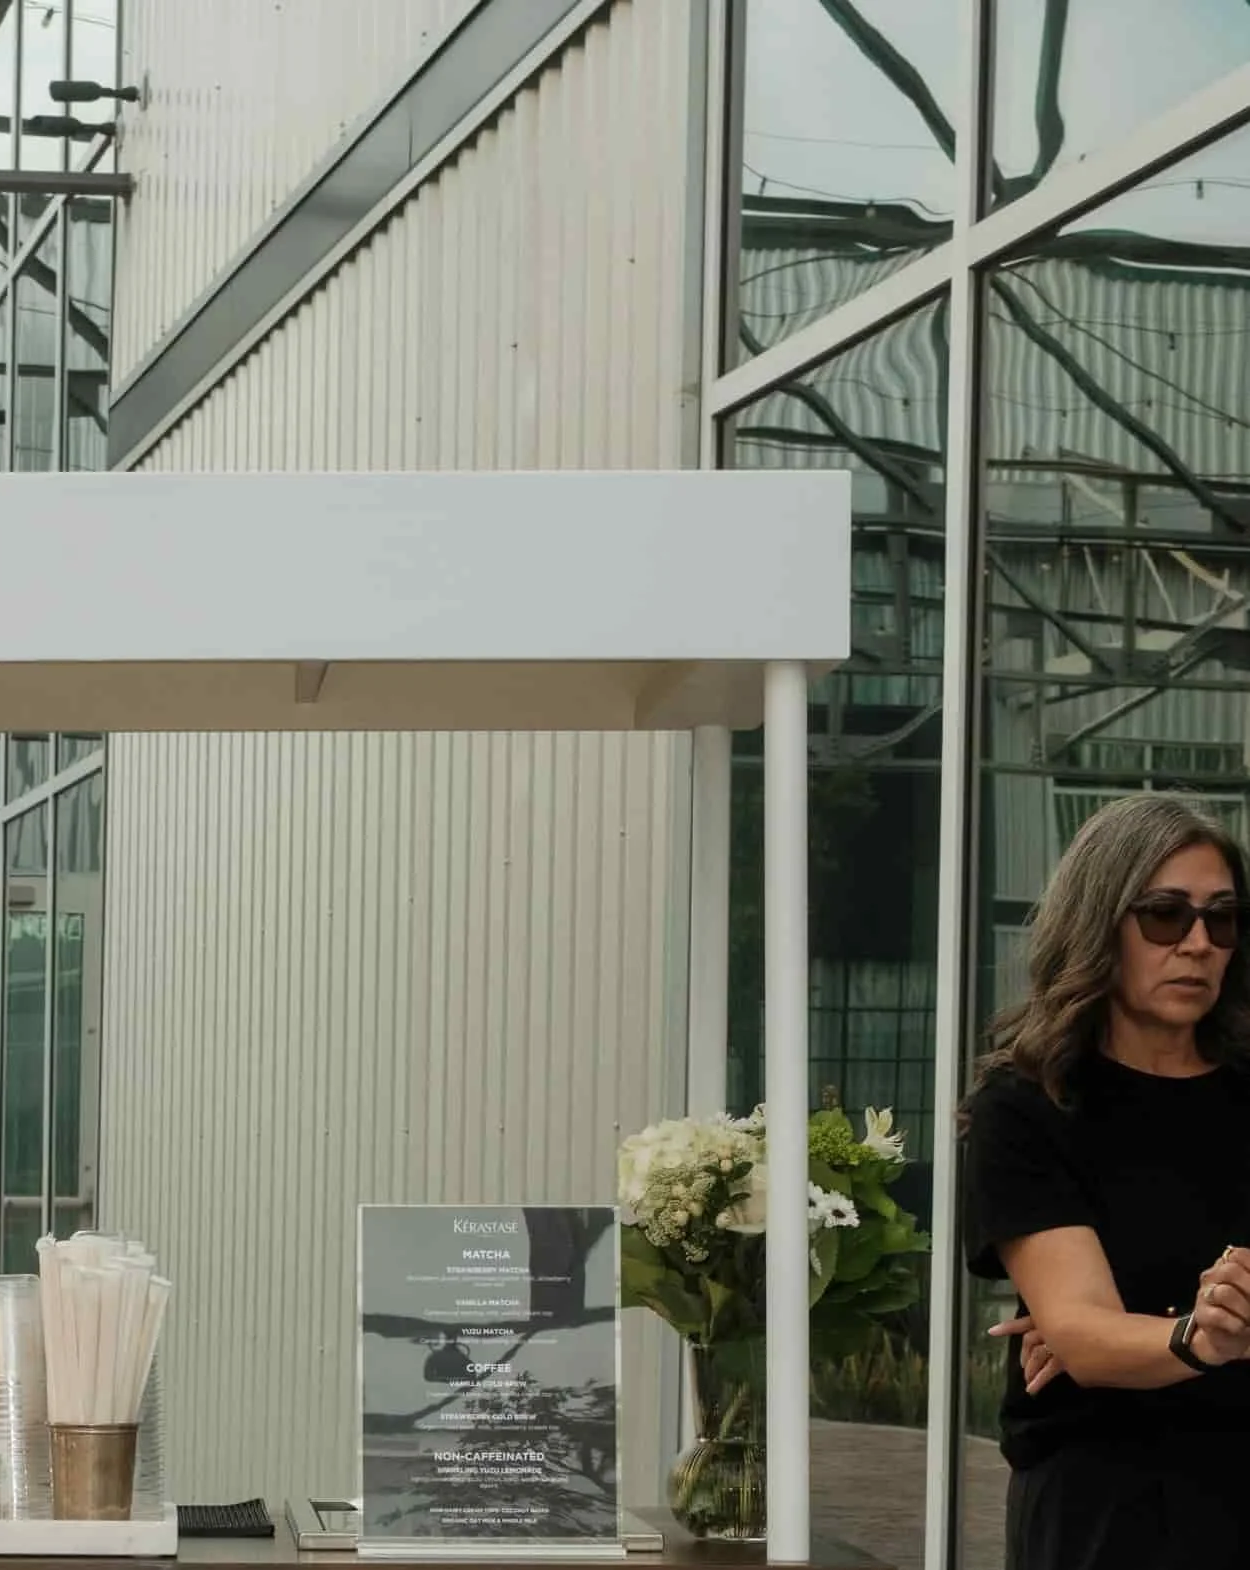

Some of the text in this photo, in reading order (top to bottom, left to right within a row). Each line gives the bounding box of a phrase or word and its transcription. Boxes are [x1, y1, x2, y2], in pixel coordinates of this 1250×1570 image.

[462, 1250, 510, 1259] MATCHA
[483, 1328, 514, 1336] MATCHA
[466, 1363, 511, 1373] COFFEE
[434, 1451, 545, 1461] NON-CAFFEINATED
